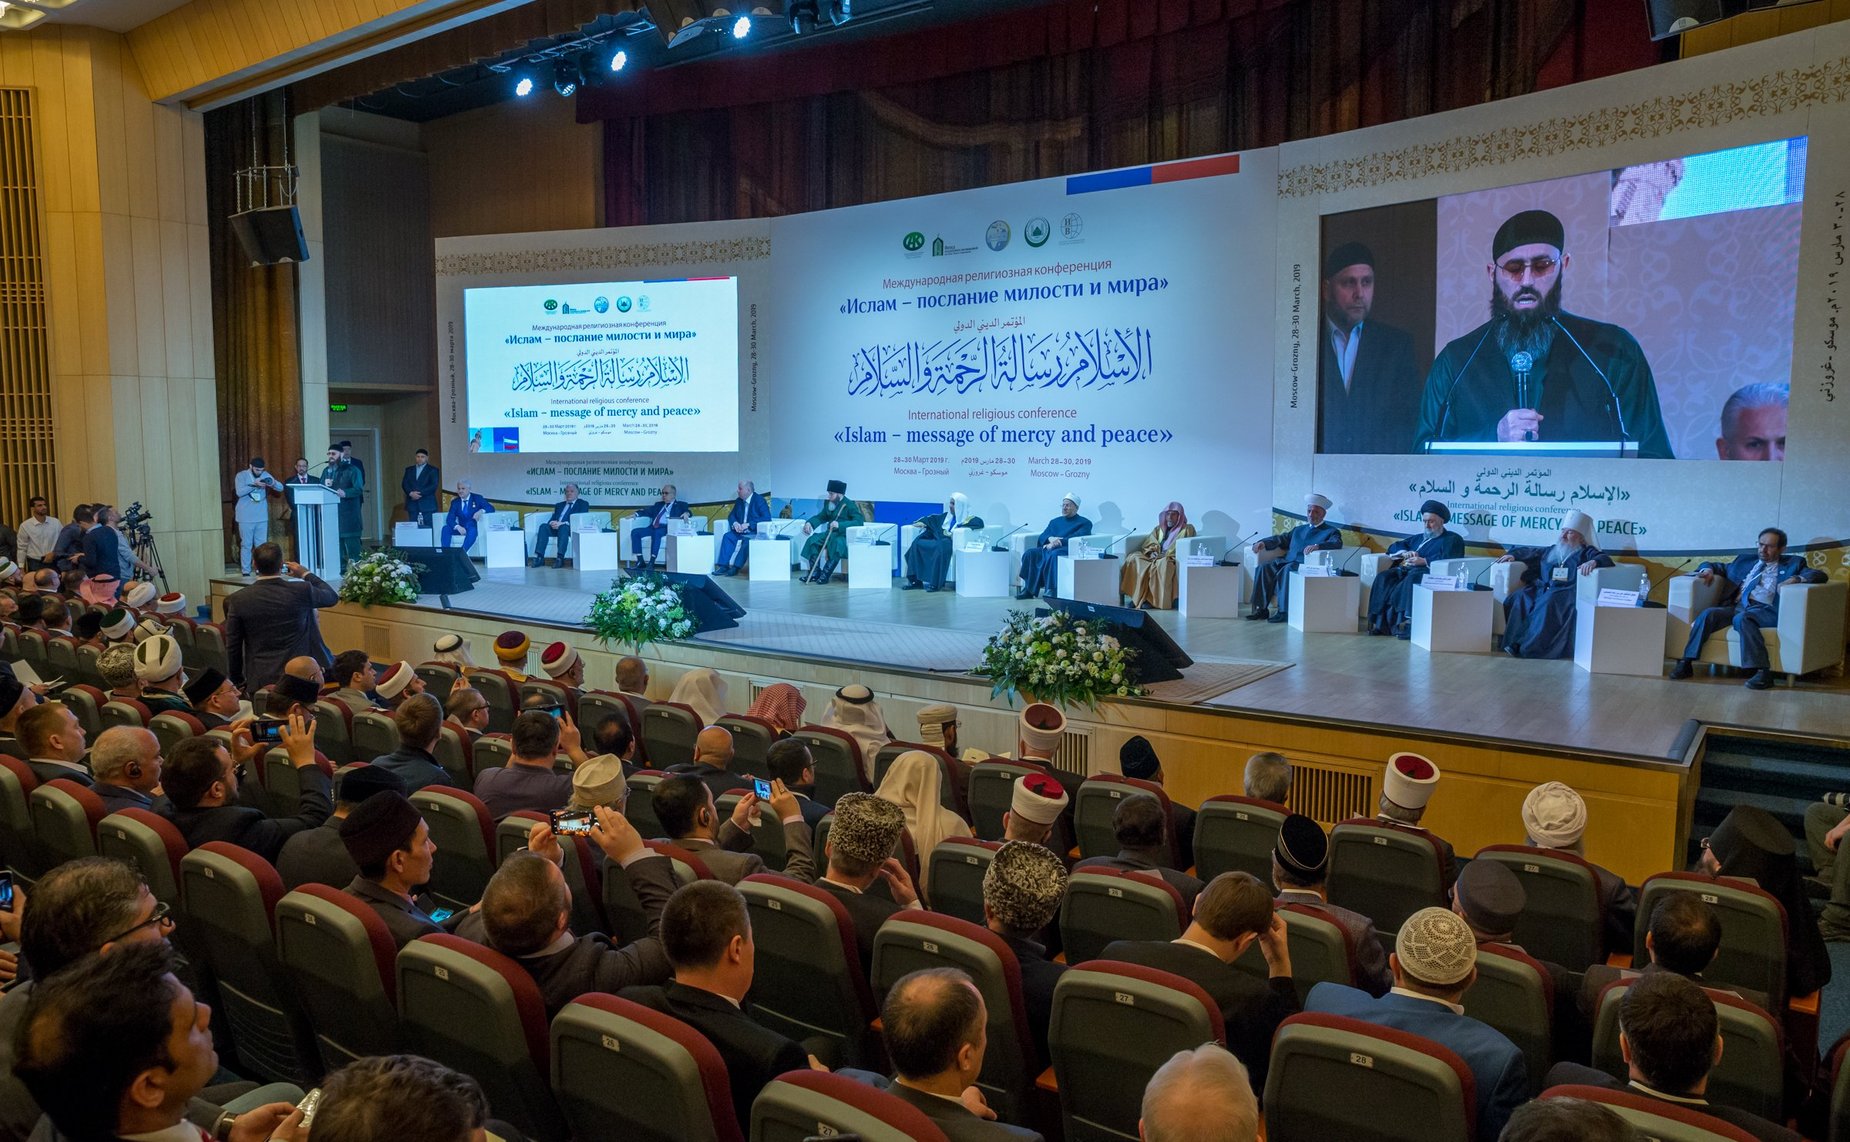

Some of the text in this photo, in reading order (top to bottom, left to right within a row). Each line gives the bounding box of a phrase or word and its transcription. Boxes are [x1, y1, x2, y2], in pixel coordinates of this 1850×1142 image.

[1832, 234, 1845, 266] مارس
[883, 260, 1112, 290] Международная религиозная конференция
[1293, 264, 1301, 282] 2019
[840, 298, 898, 314] «Ислам
[917, 290, 999, 309] послание
[1004, 283, 1084, 302] милости
[1090, 281, 1102, 296] и
[1107, 276, 1168, 296] мира»
[505, 334, 542, 344] «Ислам
[554, 333, 604, 343] послание
[606, 331, 652, 341] милости
[654, 331, 661, 340] и
[664, 330, 697, 341] мира»
[1824, 316, 1839, 351] موسكو
[589, 397, 614, 406] religious
[504, 408, 538, 418] «Islam
[550, 408, 591, 419] message
[594, 406, 605, 416] of
[607, 408, 638, 418] mercy
[640, 406, 660, 416] and
[663, 408, 701, 418] peace»
[908, 406, 1077, 422] International religious conference
[834, 426, 887, 443] «Islam
[906, 430, 974, 447] message
[980, 424, 998, 442] of
[1002, 428, 1056, 448] mercy
[1061, 424, 1096, 442] and
[1101, 428, 1173, 448] peace»
[1028, 456, 1050, 464] March
[526, 467, 556, 476] «ИСЛАМ
[564, 467, 600, 476] ПОСЛАНИЕ
[603, 467, 638, 476] МИЛОСТИ
[640, 467, 646, 476] И
[648, 467, 674, 476] МИРА»
[922, 467, 950, 476] Грозный
[1030, 469, 1059, 478] Moscow
[1064, 470, 1090, 480] Grozny
[526, 487, 551, 496] «ISLAM
[594, 488, 602, 496] OF
[605, 488, 629, 496] MERCY
[631, 488, 646, 496] AND
[1460, 486, 1470, 498] و
[1474, 479, 1519, 500] الرحمة
[1524, 480, 1566, 502] رسالة
[1447, 501, 1496, 511] International
[1499, 502, 1534, 513] religious
[1450, 512, 1498, 527] MESSAGE
[1502, 515, 1516, 527] OF
[1520, 516, 1562, 530] MERCY
[1597, 520, 1647, 535] PEACE»
[1120, 994, 1128, 1002] 27
[1356, 1056, 1366, 1065] 28
[823, 1126, 832, 1136] 27
